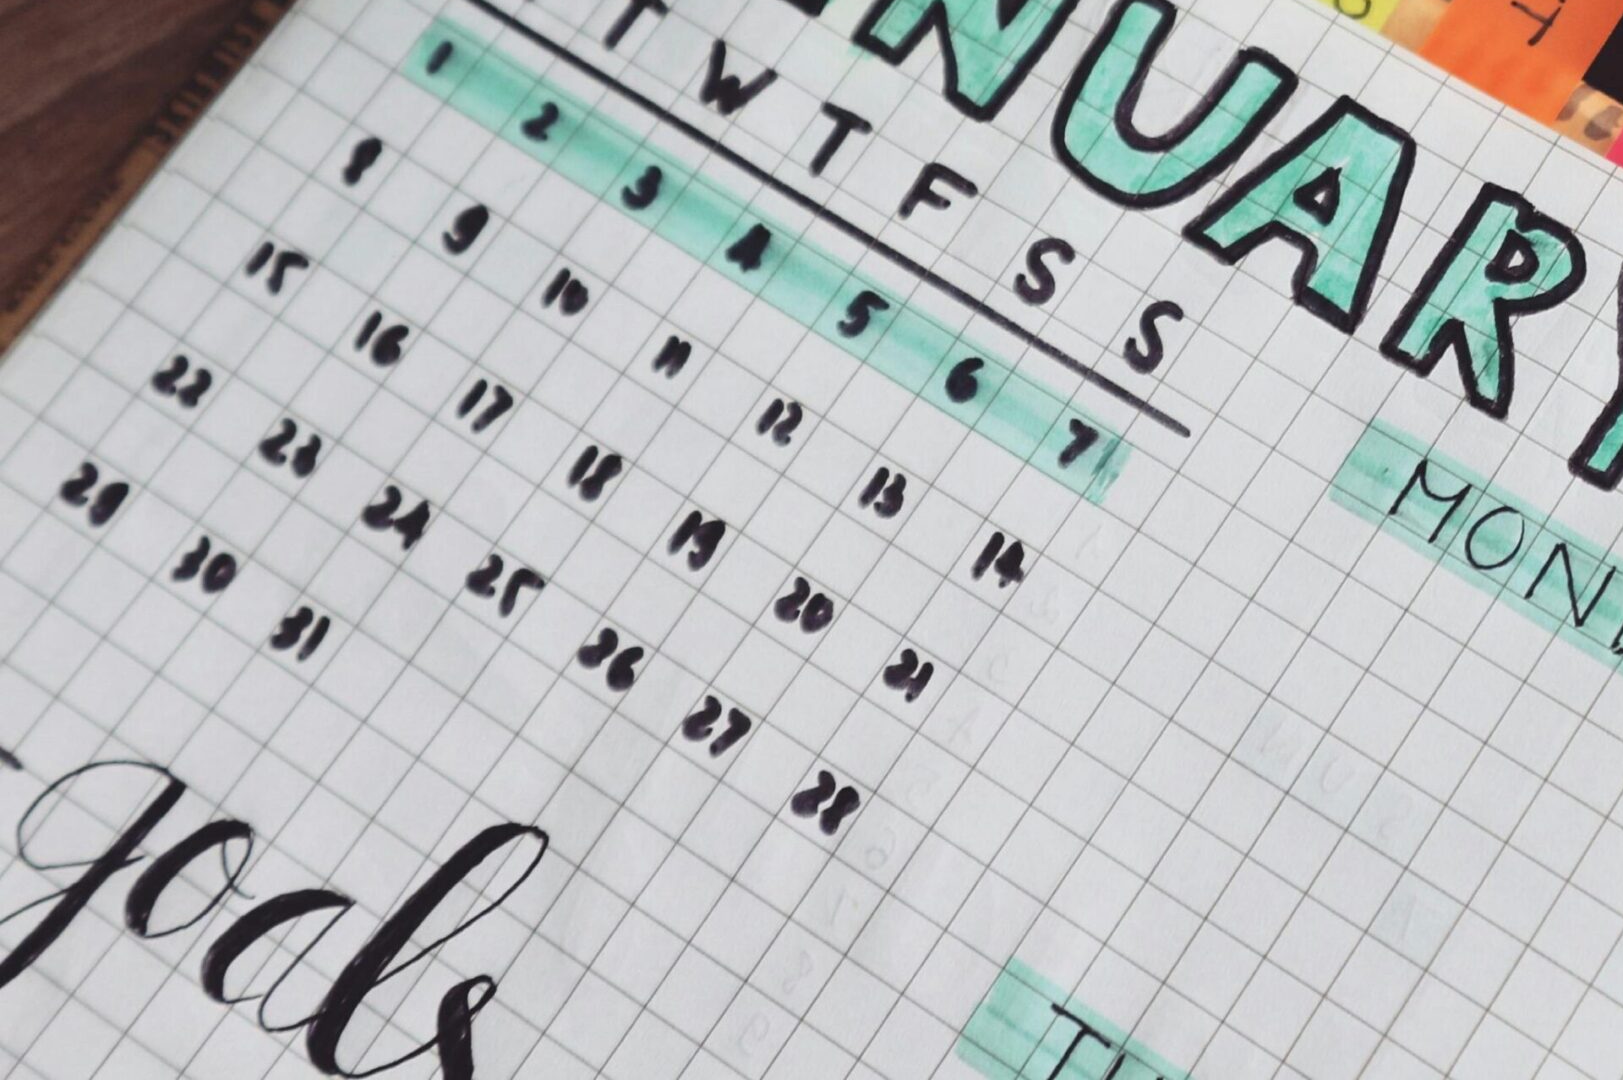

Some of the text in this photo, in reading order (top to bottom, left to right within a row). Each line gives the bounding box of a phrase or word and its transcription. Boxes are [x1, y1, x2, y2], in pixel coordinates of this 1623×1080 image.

[428, 42, 453, 73] 1
[523, 103, 559, 140] 2
[623, 166, 662, 209] 3
[840, 291, 889, 336] 5
[946, 358, 984, 402] 6
[1060, 419, 1098, 465] 7
[445, 205, 488, 253] 9
[545, 269, 588, 313] 10
[759, 399, 802, 443] 12
[861, 468, 906, 516] 13
[974, 532, 1024, 587] 14
[702, 40, 777, 114] W
[812, 103, 871, 174] T
[900, 163, 977, 216] F
[1016, 238, 1074, 303] S
[1125, 301, 1183, 372] S
[153, 356, 211, 406] 22
[363, 486, 429, 549] 24
[468, 555, 545, 614] 25
[579, 629, 643, 689] 26
[684, 696, 751, 754] 27
[174, 537, 236, 591] 30
[272, 607, 330, 659] 31
[248, 243, 933, 701] 15 16 17 18 19 20 21
